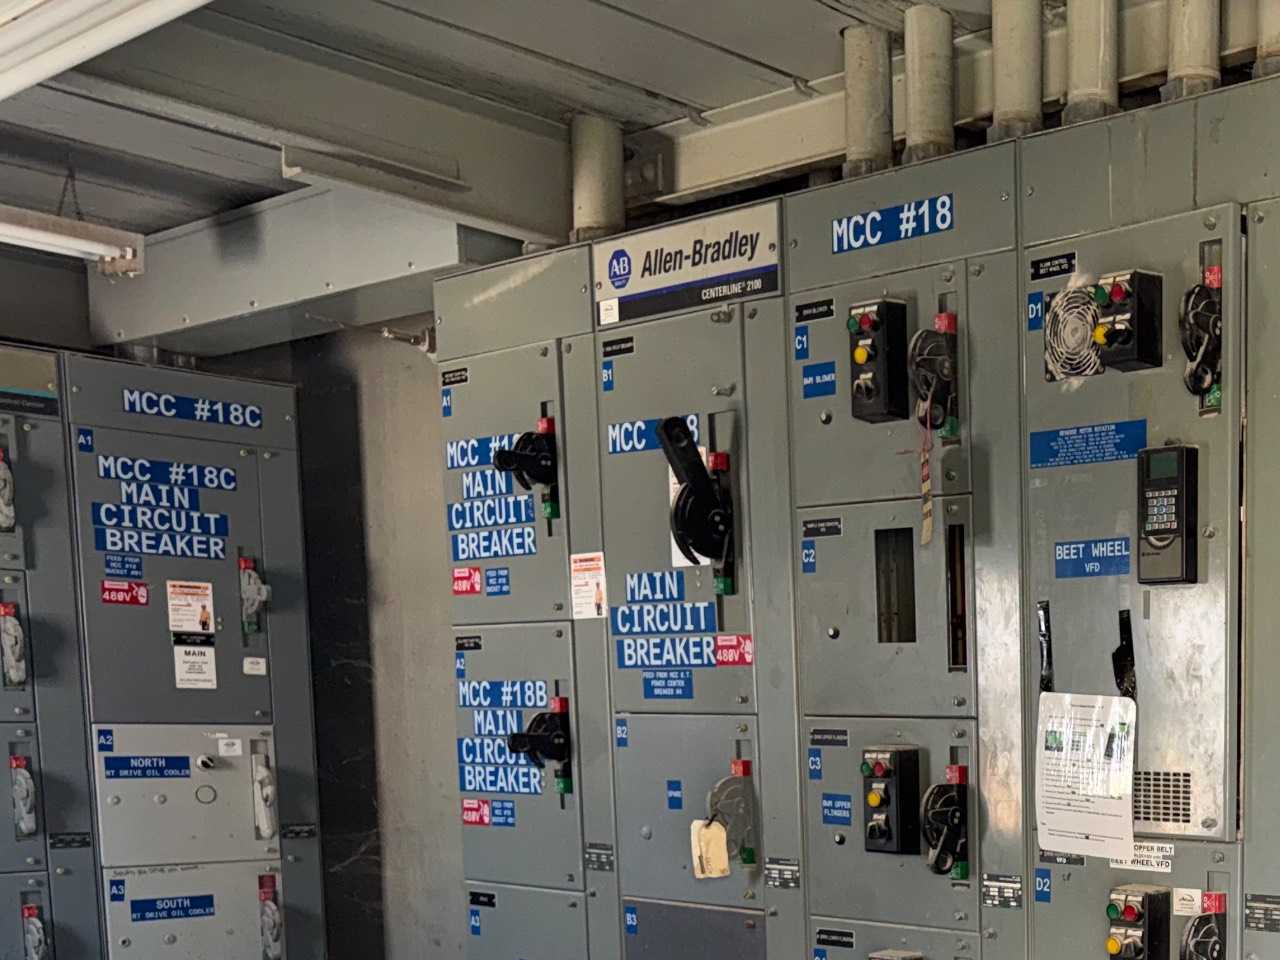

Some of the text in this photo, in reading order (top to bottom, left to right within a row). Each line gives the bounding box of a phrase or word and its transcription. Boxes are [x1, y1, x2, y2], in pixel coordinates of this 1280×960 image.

[832, 195, 952, 252] MCC #18
[641, 230, 760, 278] Allen-Bradley
[611, 257, 629, 275] AB
[1028, 303, 1042, 319] D1
[795, 335, 807, 349] C1
[603, 368, 612, 382] B1
[123, 389, 262, 427] MCC #18C
[78, 434, 92, 445] A1
[608, 421, 646, 452] MCC
[447, 439, 479, 468] MCC
[98, 455, 236, 490] MCC #18C
[462, 470, 506, 499] MAIN
[120, 482, 189, 509] MAIN
[99, 504, 221, 535] CIRCUIT
[452, 495, 528, 529] CIRCUIT
[105, 528, 225, 559] BREAKER
[458, 527, 536, 560] BREAKER
[1056, 540, 1130, 560] BEET WHEEL
[803, 550, 815, 562] C2
[1085, 562, 1100, 573] VFD
[626, 571, 678, 600] MAIN
[103, 591, 131, 602] 480V
[617, 602, 709, 632] CIRCUIT
[624, 636, 716, 666] BREAKER
[717, 648, 739, 662] 480V
[459, 681, 548, 707] MCC #18B
[474, 709, 517, 735] MAIN
[99, 735, 112, 744] A2
[616, 726, 627, 738] B2
[130, 758, 166, 768] NORTH
[809, 757, 821, 769] C3
[119, 769, 142, 777] DRIVE
[164, 769, 190, 777] COOLER
[464, 766, 541, 794] BREAKER
[1130, 858, 1154, 867] WHEEL
[1156, 860, 1170, 868] VFD
[111, 885, 125, 894] A3
[1036, 877, 1050, 892] D2
[156, 899, 190, 909] SOUTH
[146, 911, 166, 919] DRIVE
[627, 914, 637, 926] B3
